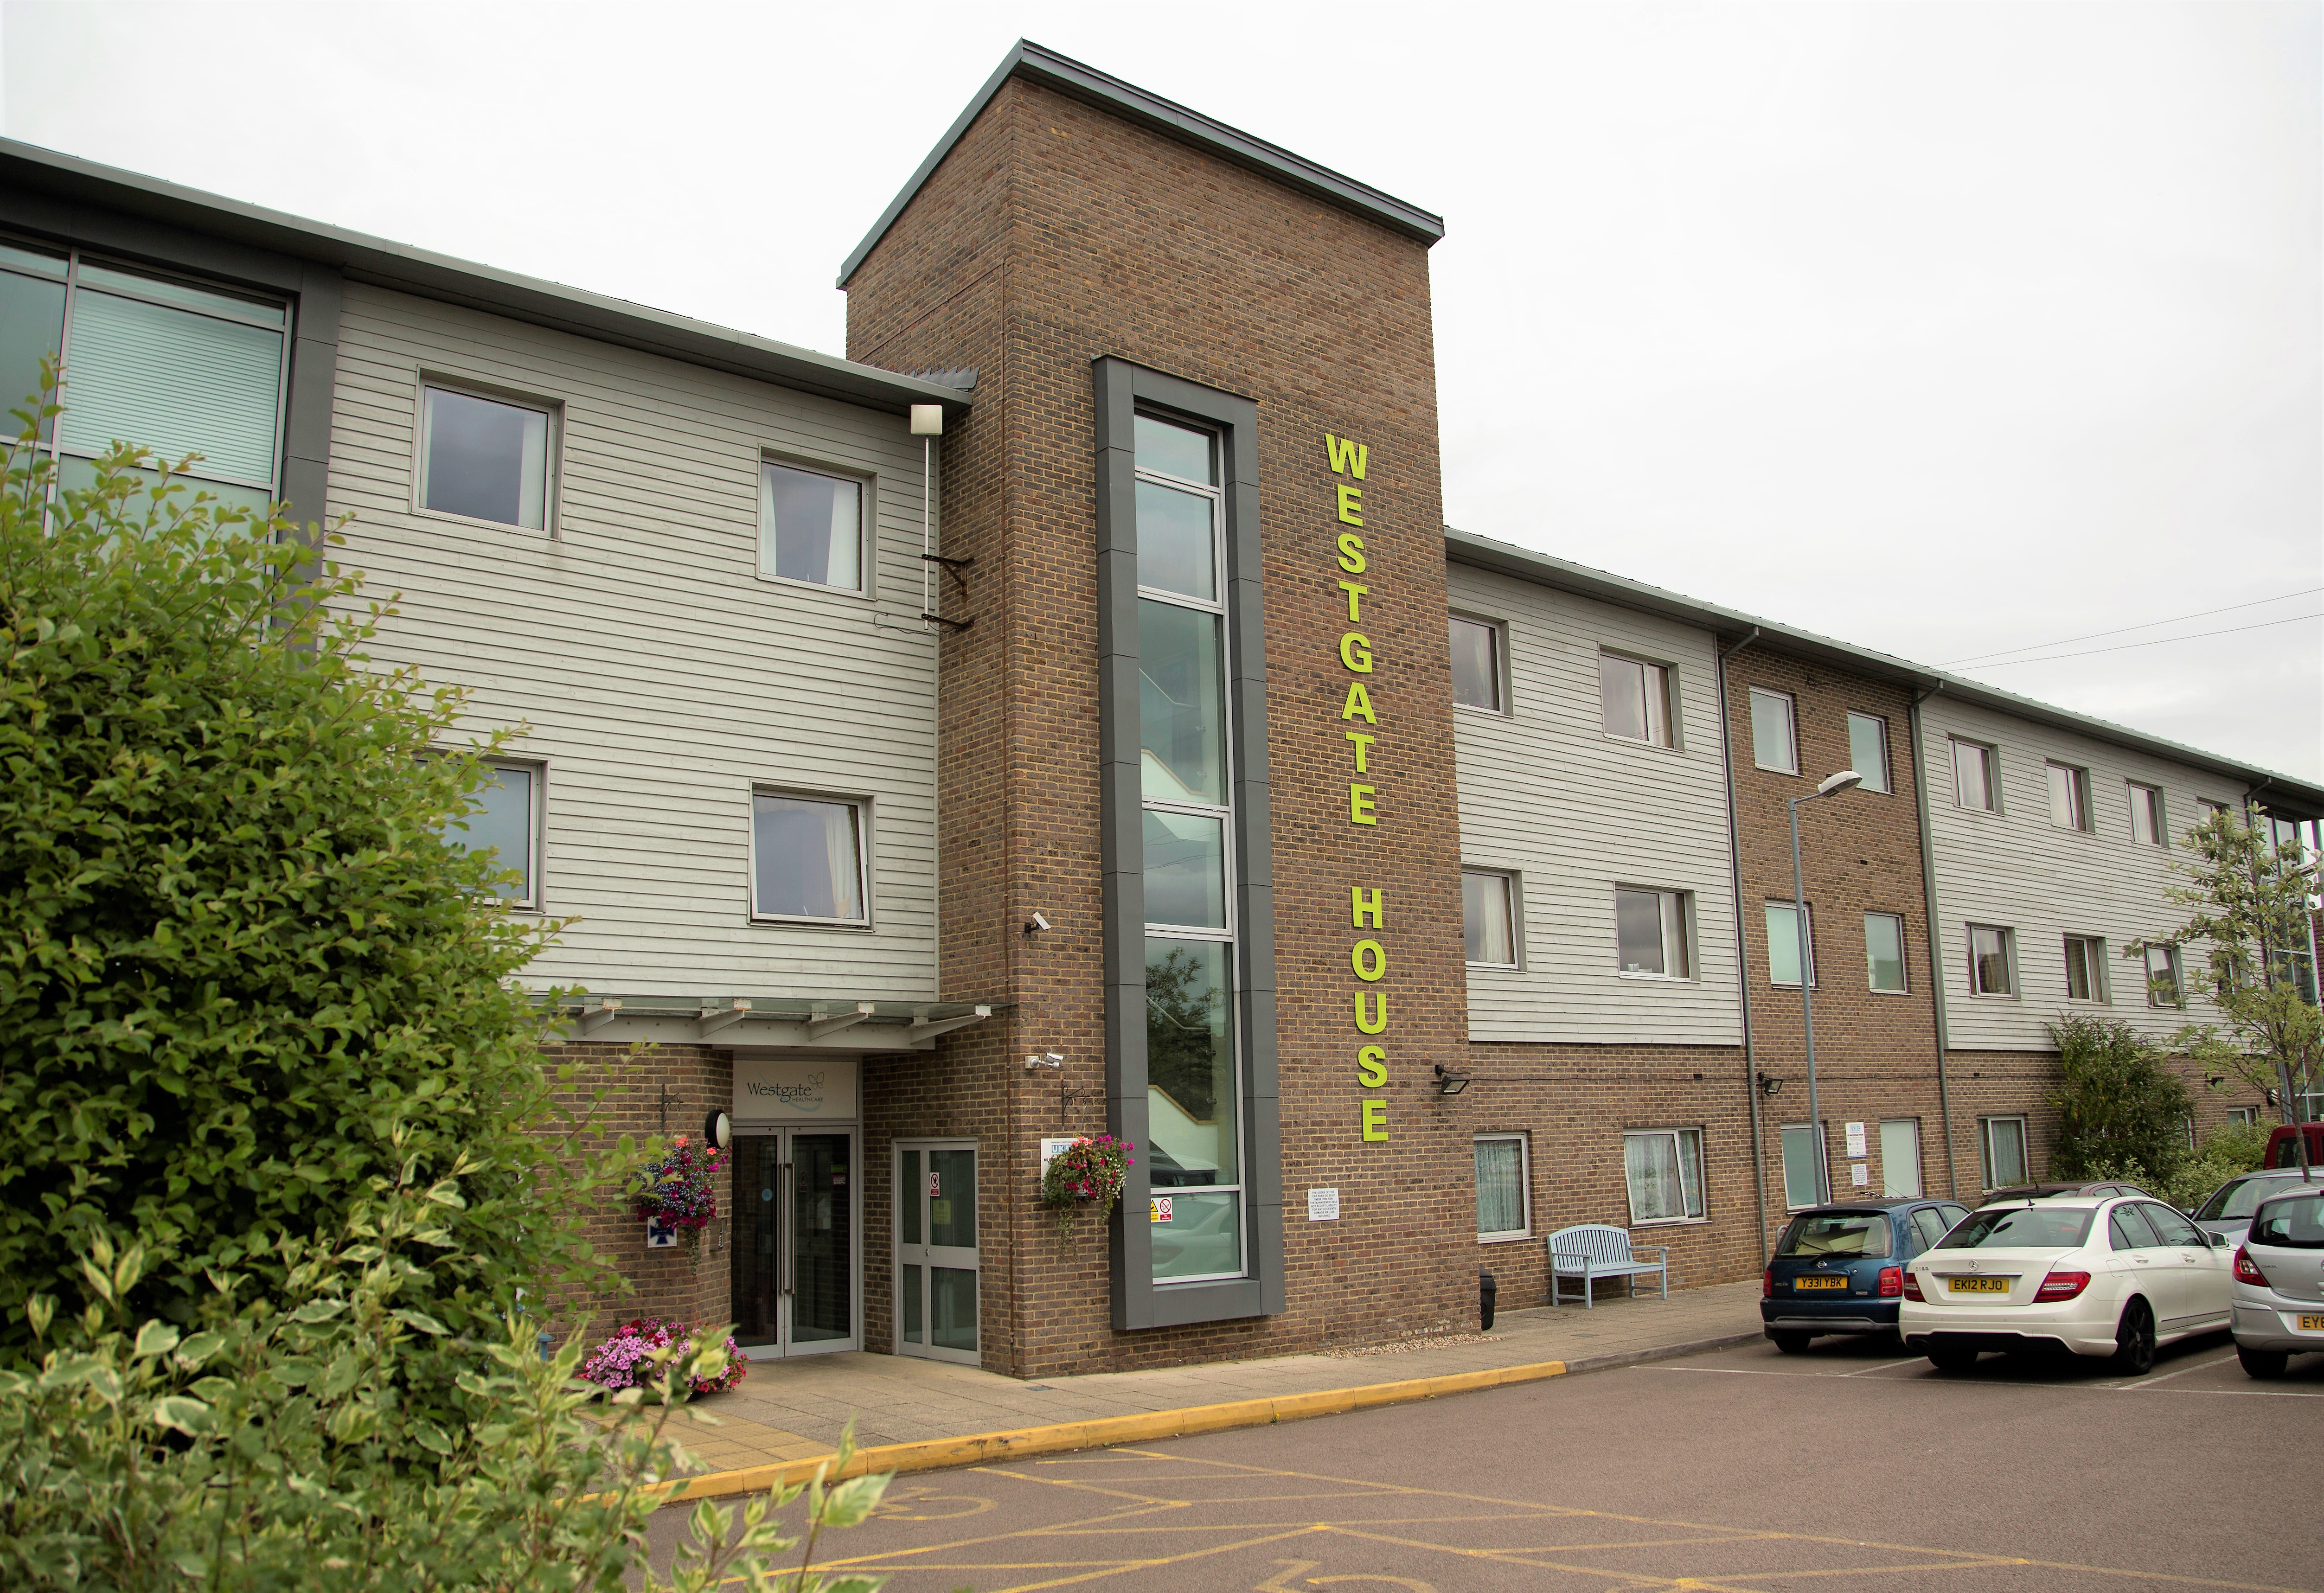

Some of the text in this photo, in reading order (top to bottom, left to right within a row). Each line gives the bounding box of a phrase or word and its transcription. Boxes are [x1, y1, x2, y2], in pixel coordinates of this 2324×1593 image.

[1325, 433, 1389, 1141] WESTGATE HOUSE
[747, 1082, 812, 1102] Westgate
[1802, 1278, 1841, 1287] Y331 YBK
[1954, 1280, 2002, 1290] EK12 RJO
